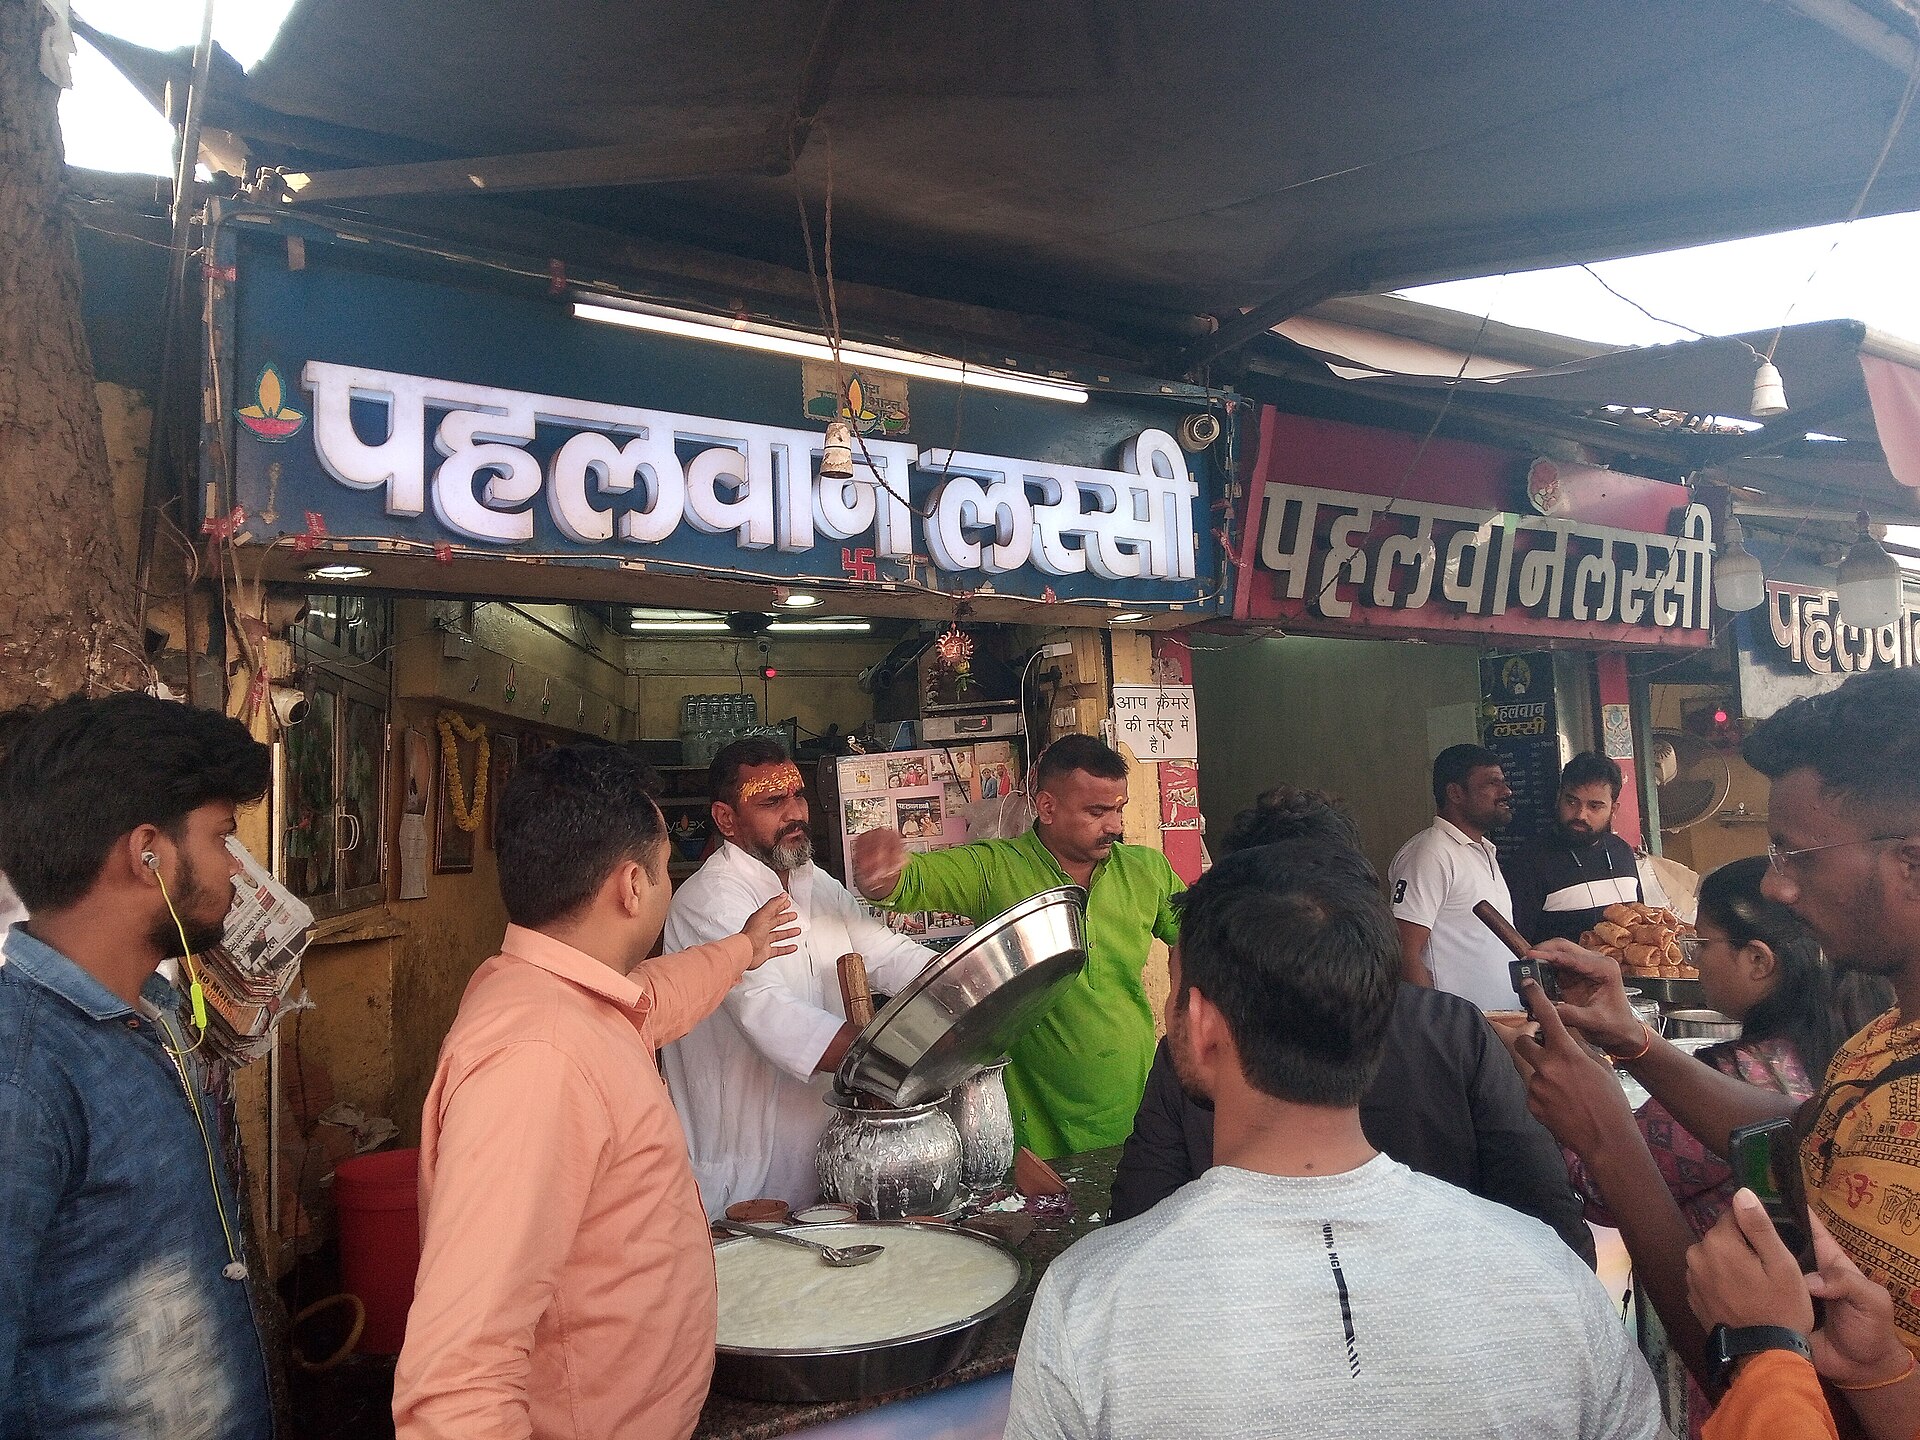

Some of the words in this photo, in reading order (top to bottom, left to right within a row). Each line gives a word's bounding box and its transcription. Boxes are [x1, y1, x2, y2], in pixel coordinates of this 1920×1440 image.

[301, 360, 919, 560] पहलवान
[918, 428, 1199, 581] लस्सी
[1116, 696, 1148, 710] आप
[1155, 692, 1190, 710] कैमरे
[1124, 714, 1142, 732] की
[1179, 714, 1189, 732] में
[1493, 716, 1547, 737] लस्सी
